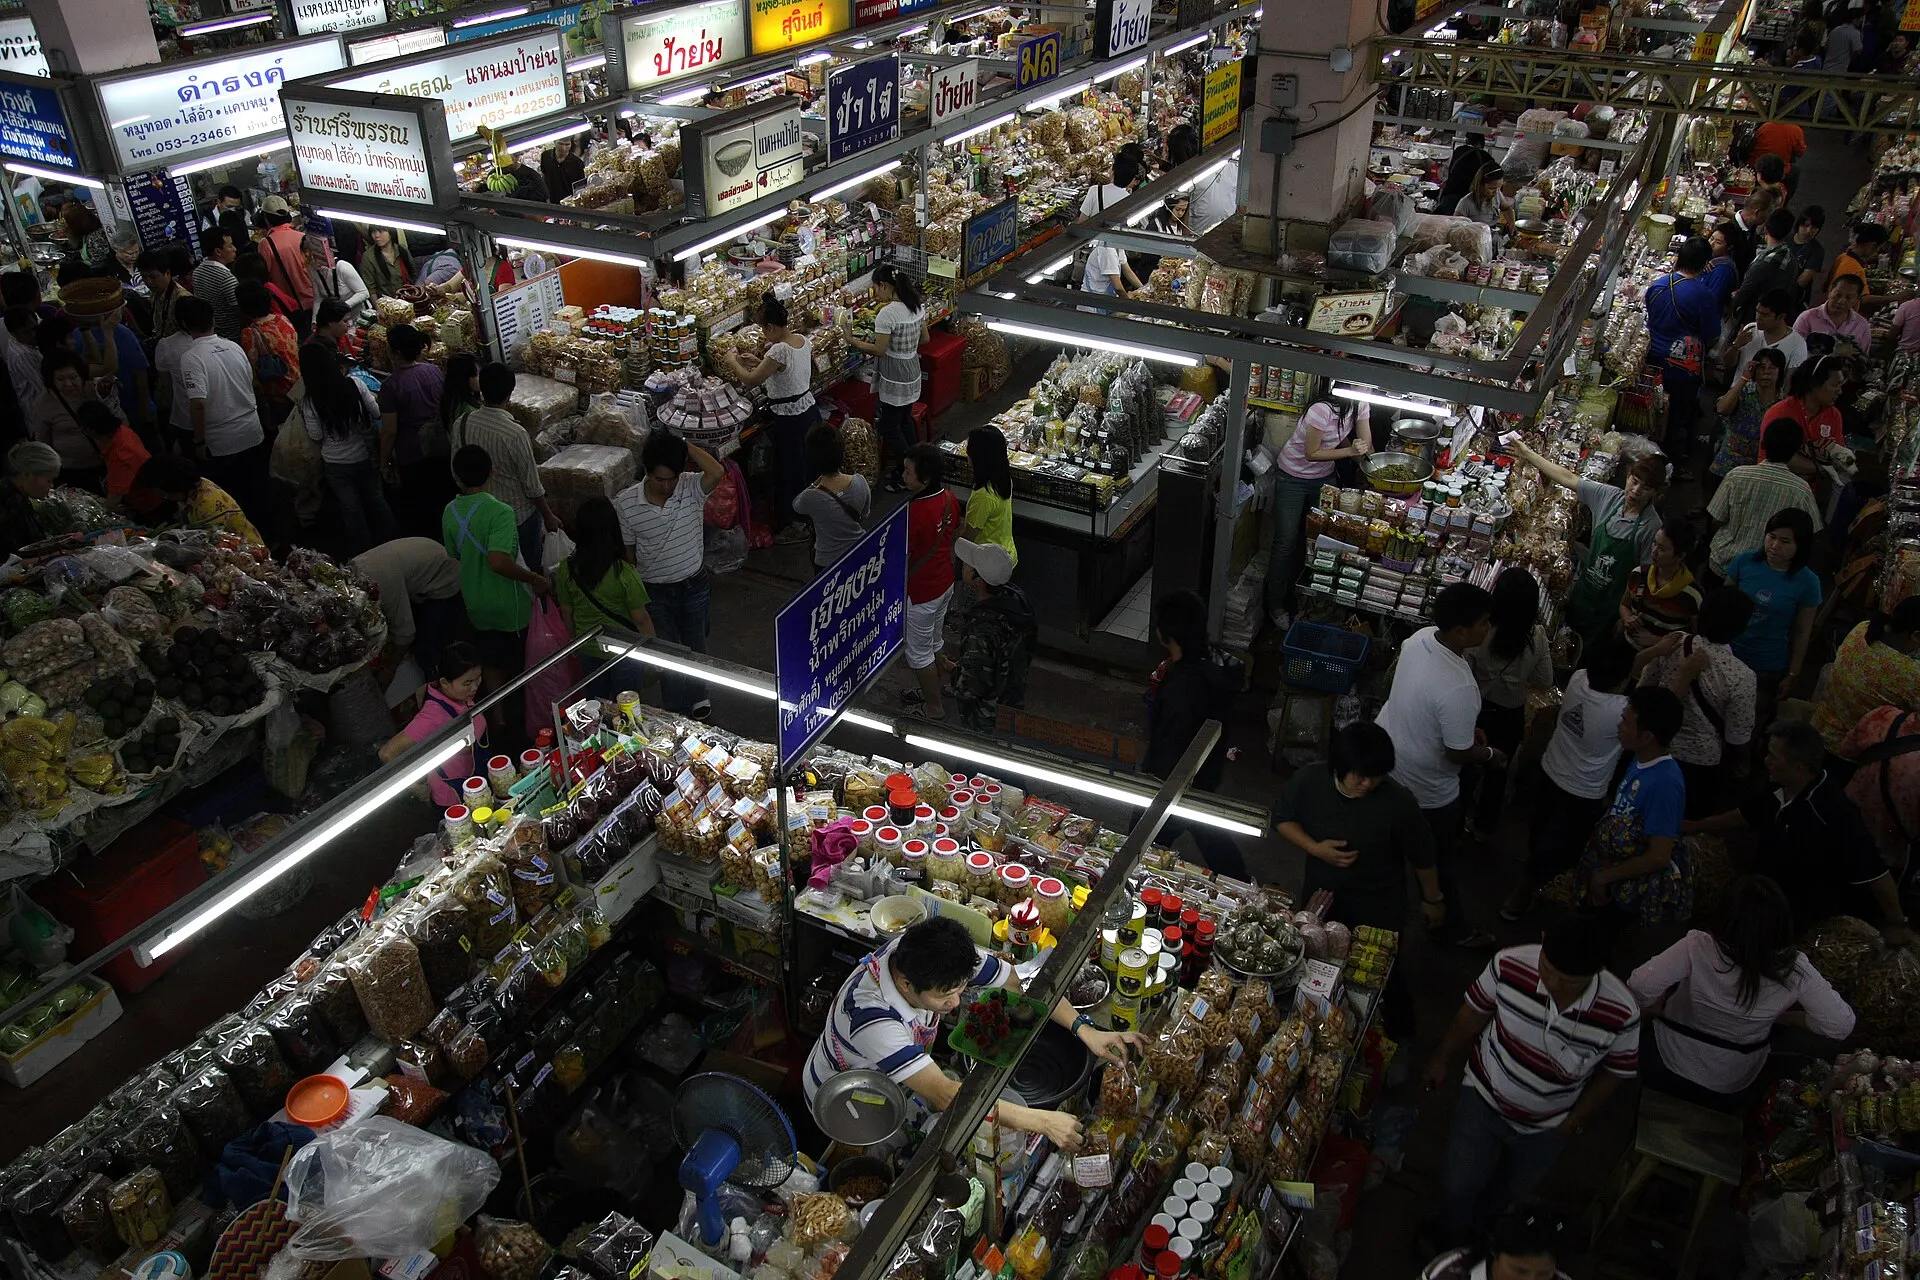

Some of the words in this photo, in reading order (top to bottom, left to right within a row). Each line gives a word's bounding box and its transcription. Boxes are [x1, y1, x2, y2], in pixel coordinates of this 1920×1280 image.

[782, 3, 823, 42] สุจินต์
[1111, 2, 1149, 52] ป้าย่น
[465, 45, 558, 86] แหนมป้าย่น
[654, 29, 723, 77] ป้าย่น
[1020, 37, 1057, 85] มล
[176, 57, 286, 103] ดำรงค์
[935, 71, 974, 117] ป้าย่น
[123, 117, 172, 141] หมูทอด
[223, 96, 269, 115] แคบหมู
[296, 143, 333, 164] หมูทอด
[808, 588, 886, 673] น้ำพริกหนุ่ม
[856, 640, 888, 682] 251737
